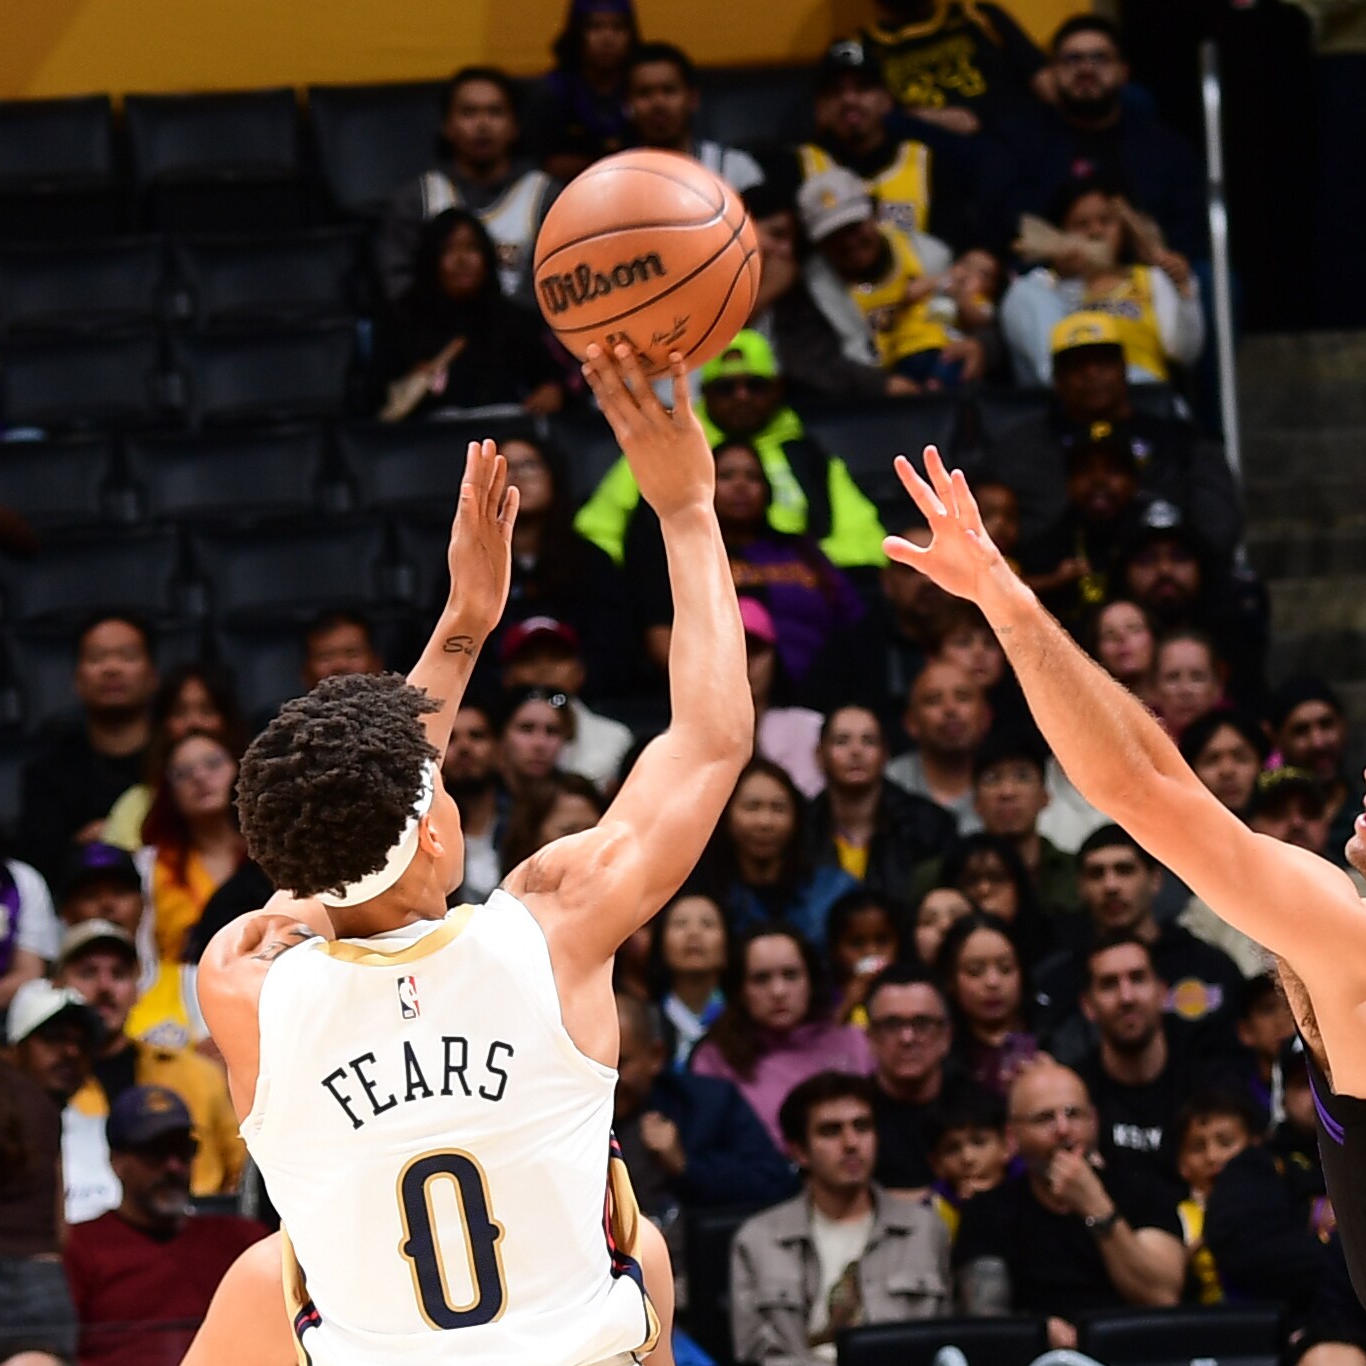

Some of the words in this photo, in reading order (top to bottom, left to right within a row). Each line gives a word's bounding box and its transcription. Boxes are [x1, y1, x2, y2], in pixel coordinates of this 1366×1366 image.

[539, 253, 666, 314] Wilson
[321, 1036, 515, 1130] FEARS
[396, 1147, 507, 1331] 0
